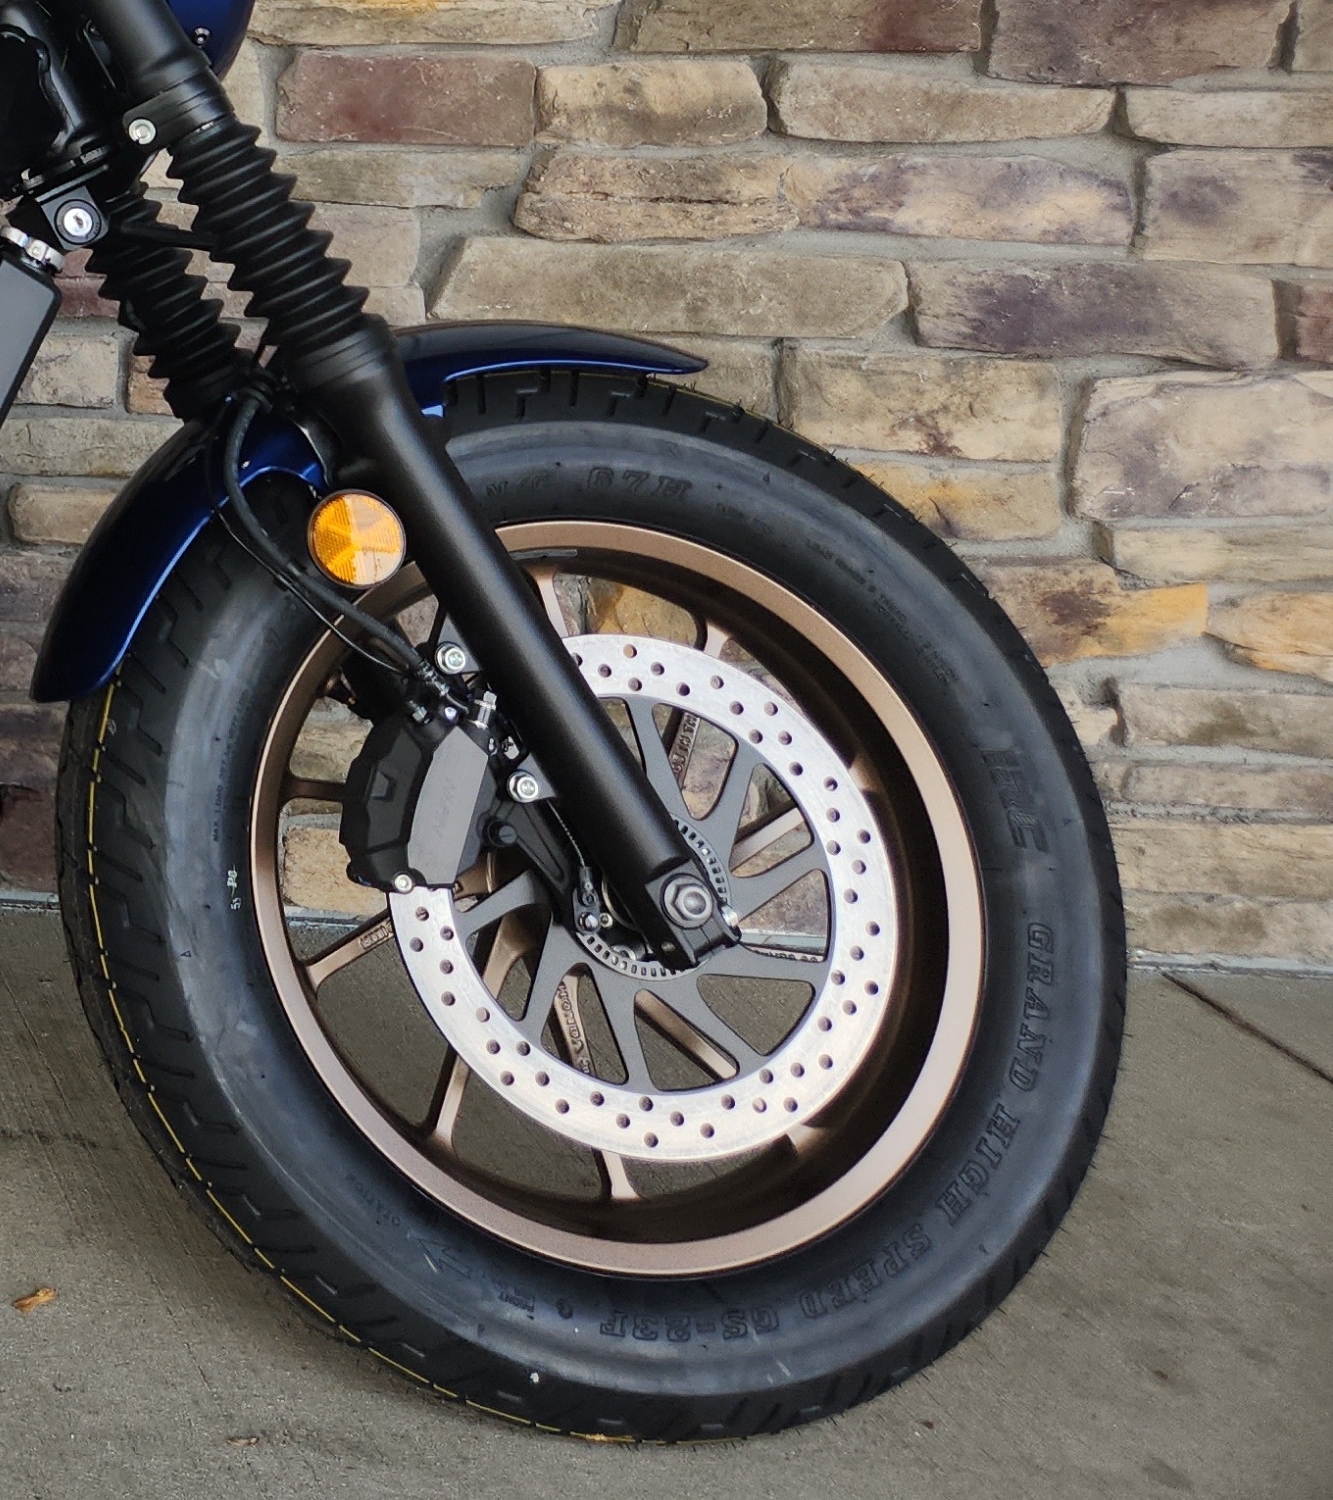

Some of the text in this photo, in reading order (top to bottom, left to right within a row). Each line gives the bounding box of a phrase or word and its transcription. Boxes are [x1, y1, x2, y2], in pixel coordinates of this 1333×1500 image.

[1003, 921, 1055, 1095] GRAND
[929, 1101, 1025, 1228] HIGH
[794, 1218, 938, 1324] SPEED
